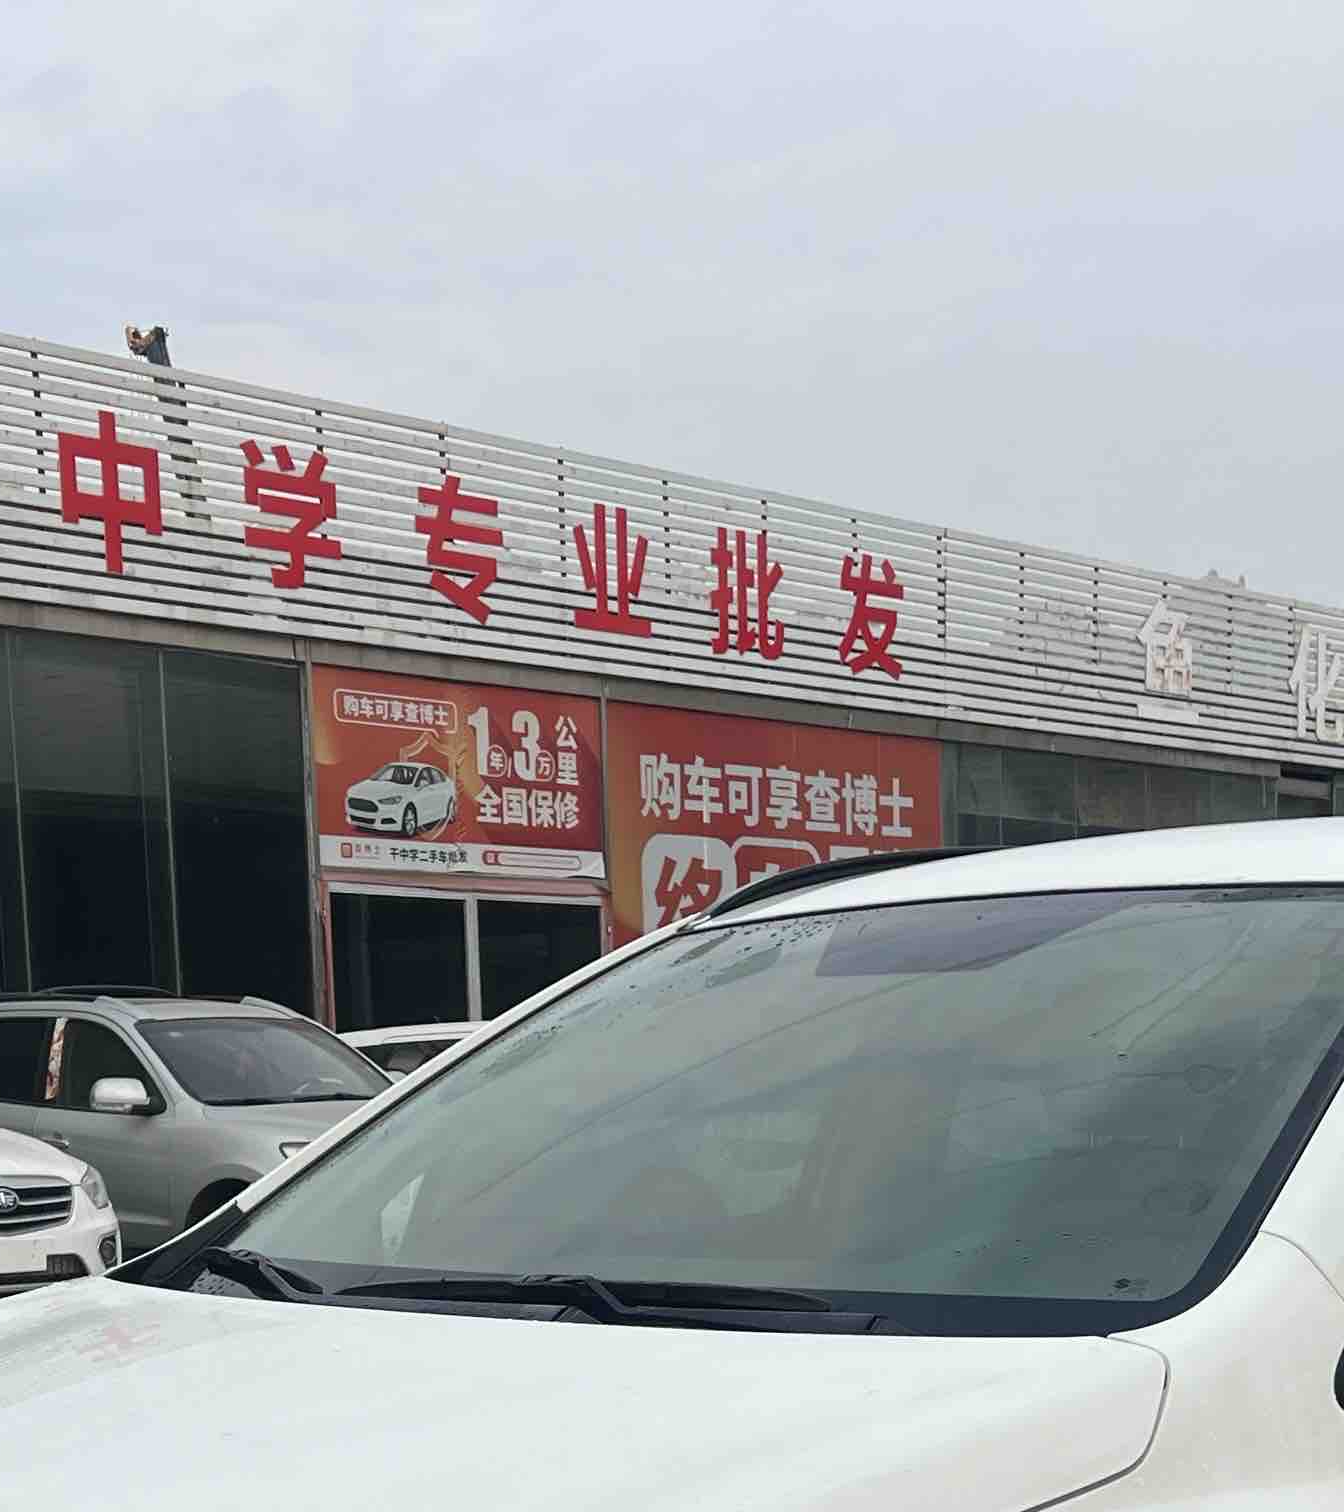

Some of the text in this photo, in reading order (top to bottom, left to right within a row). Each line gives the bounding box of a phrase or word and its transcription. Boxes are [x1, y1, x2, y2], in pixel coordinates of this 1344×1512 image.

[343, 694, 449, 727] 购车可享查博士
[475, 783, 580, 830] 全国保修
[639, 752, 914, 838] 购车可享查博士
